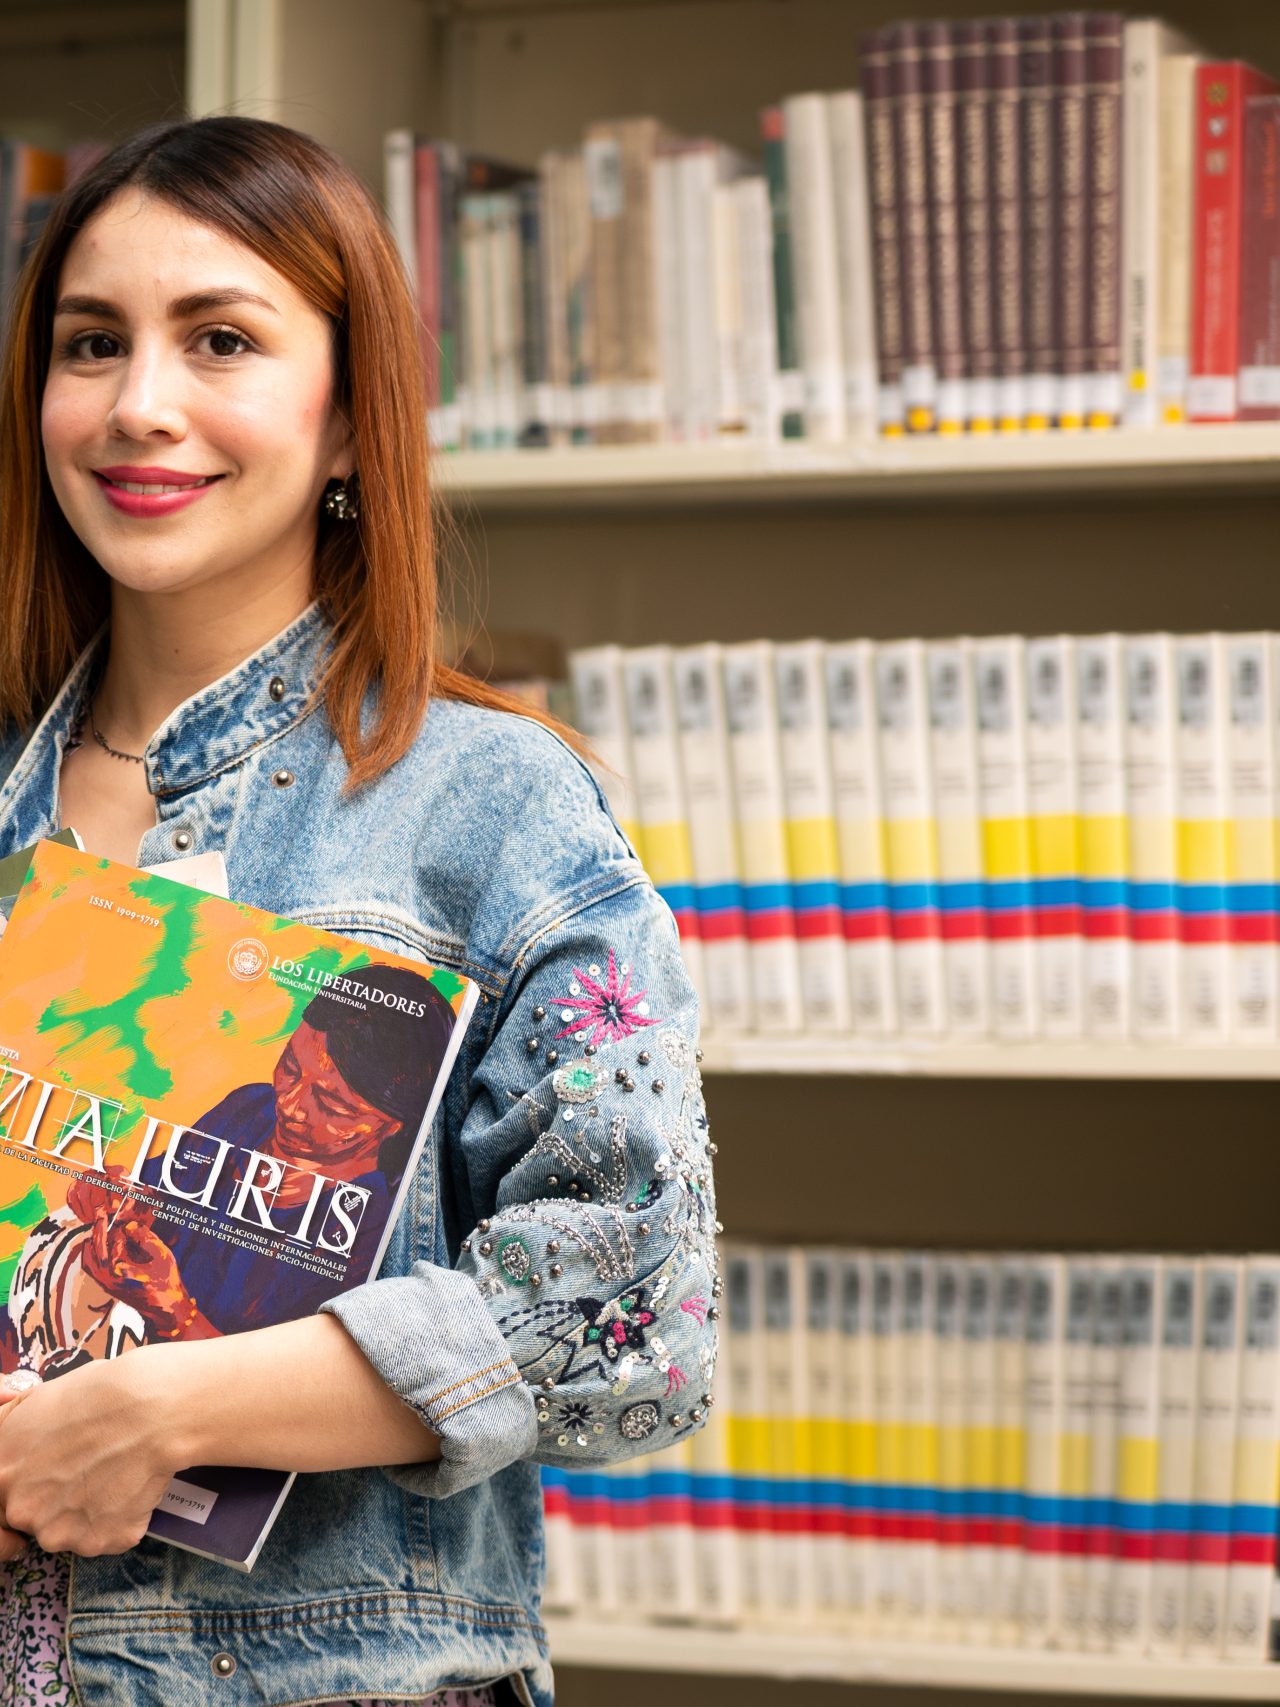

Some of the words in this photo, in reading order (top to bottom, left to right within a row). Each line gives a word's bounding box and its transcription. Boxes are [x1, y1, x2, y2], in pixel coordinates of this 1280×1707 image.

[88, 895, 114, 911] ISSN
[116, 906, 160, 928] 1909-5759
[268, 972, 312, 993] FUNDACIÓN
[313, 987, 367, 1011] UNIVERSITARIA
[271, 955, 304, 978] LOS
[307, 967, 426, 1018] LIBERTADORES
[4, 1146, 15, 1156] DE
[17, 1151, 28, 1161] LA
[30, 1155, 70, 1176] FACULTAD
[72, 1170, 84, 1181] DE
[85, 1175, 125, 1195] DERECHO,
[127, 1190, 164, 1209] CIENCIAS
[166, 1204, 208, 1224] POLÍTICAS
[219, 1221, 268, 1245] RELACIONES
[270, 1240, 348, 1273] INTERNACIONALES
[119, 1114, 372, 1258] IURIS
[152, 1209, 186, 1226] CENTRO
[188, 1221, 199, 1231] DE
[201, 1226, 274, 1257] INVESTIGACIONES
[276, 1253, 345, 1282] SOCIO-JURÍDICAS
[167, 1492, 207, 1512] 1909-5759
